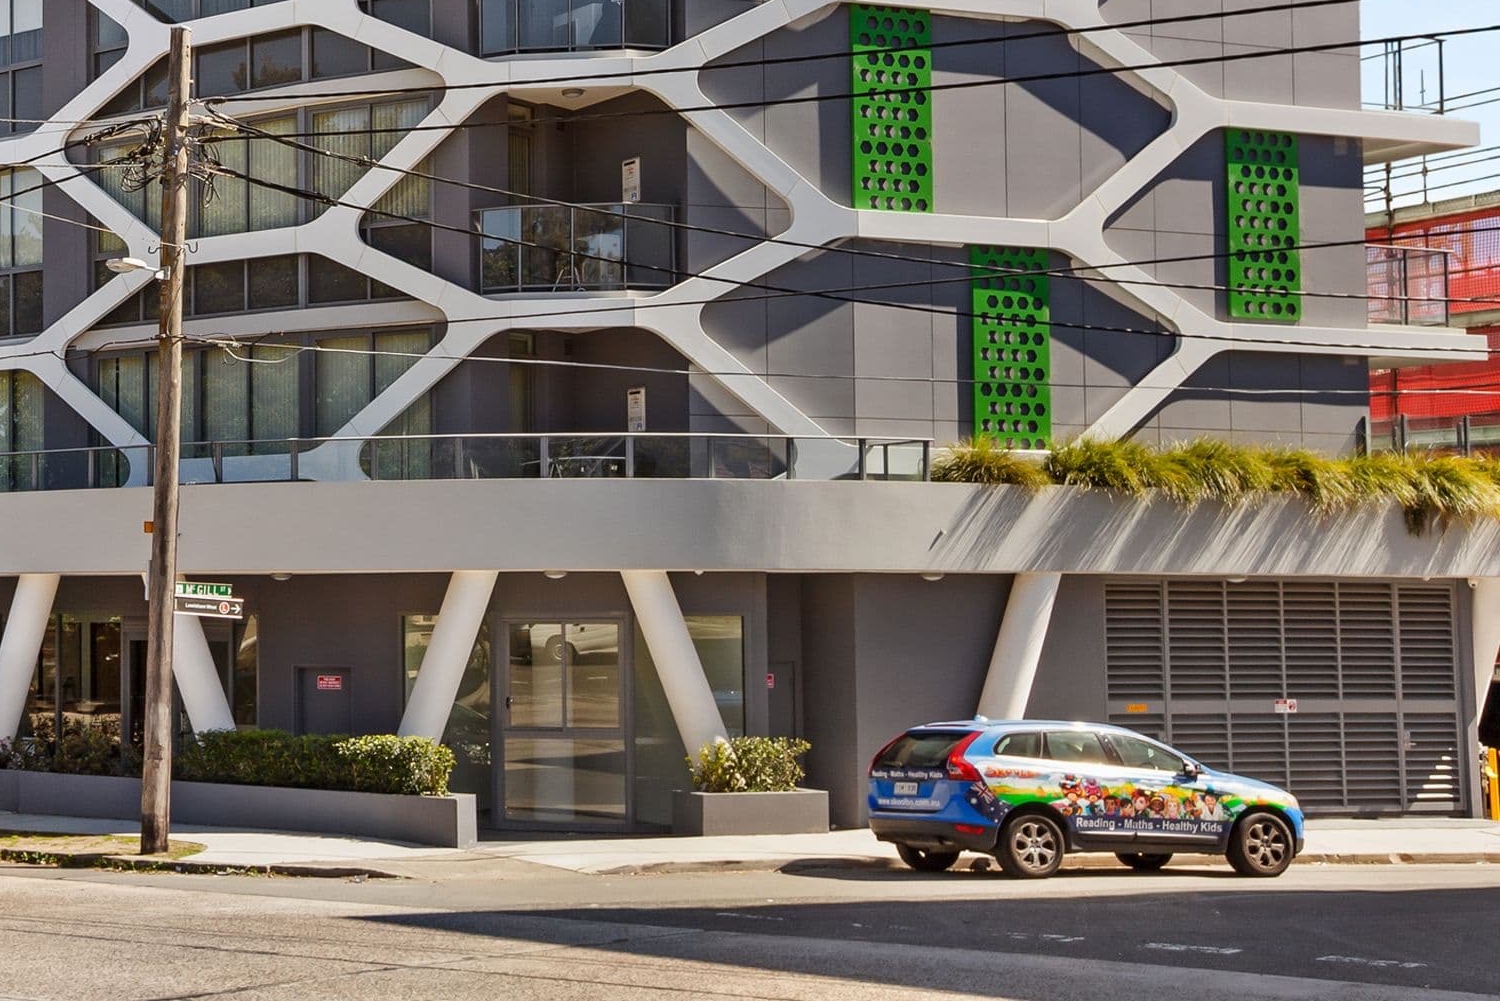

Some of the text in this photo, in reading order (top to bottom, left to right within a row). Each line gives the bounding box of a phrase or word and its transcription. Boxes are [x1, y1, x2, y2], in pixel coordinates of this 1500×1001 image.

[1076, 817, 1115, 831] Reading
[1124, 819, 1154, 830] Maths
[1162, 820, 1199, 834] Healthy
[1200, 821, 1223, 833] Kids
